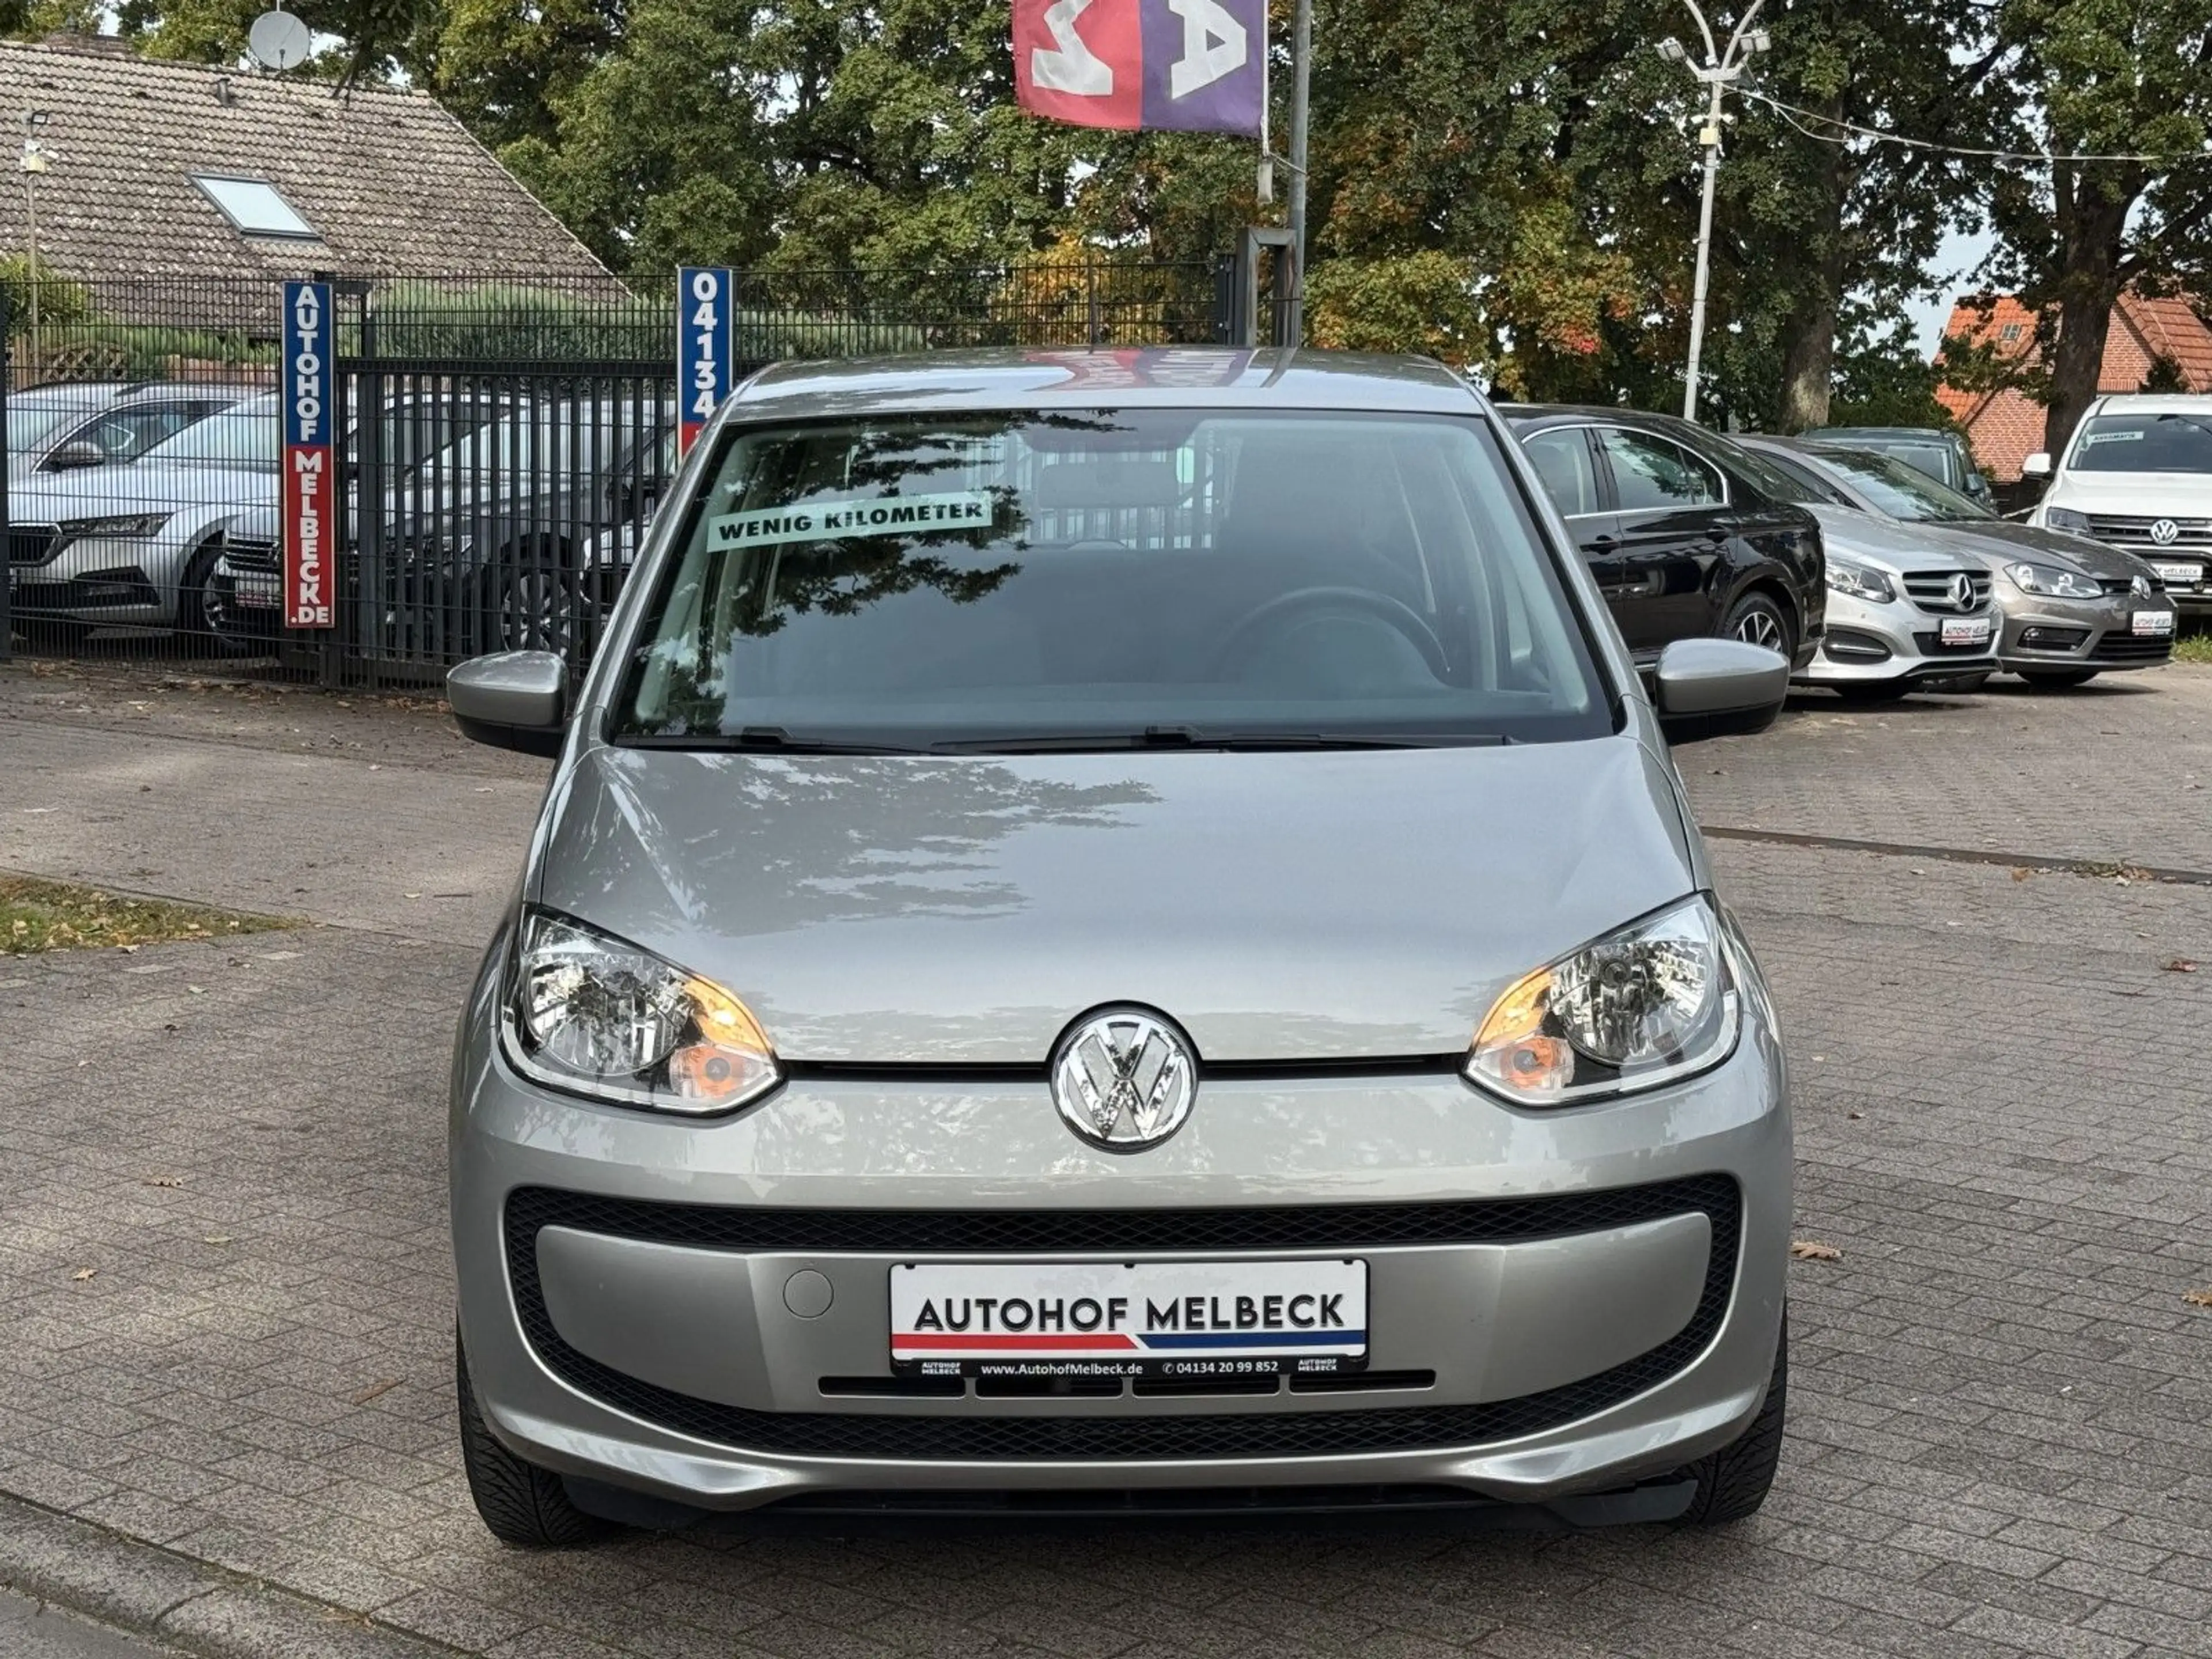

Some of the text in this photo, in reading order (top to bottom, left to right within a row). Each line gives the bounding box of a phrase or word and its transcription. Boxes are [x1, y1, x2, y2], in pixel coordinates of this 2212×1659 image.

[692, 272, 718, 420] 04134
[294, 286, 323, 605] AUTOHOF MELBECK
[719, 502, 983, 540] WENIG KILOMETER
[913, 1293, 1346, 1332] AUTOHOF MELBECK
[981, 1361, 1279, 1375] www.AutohofMelbeck.de 04134 20 99 852
